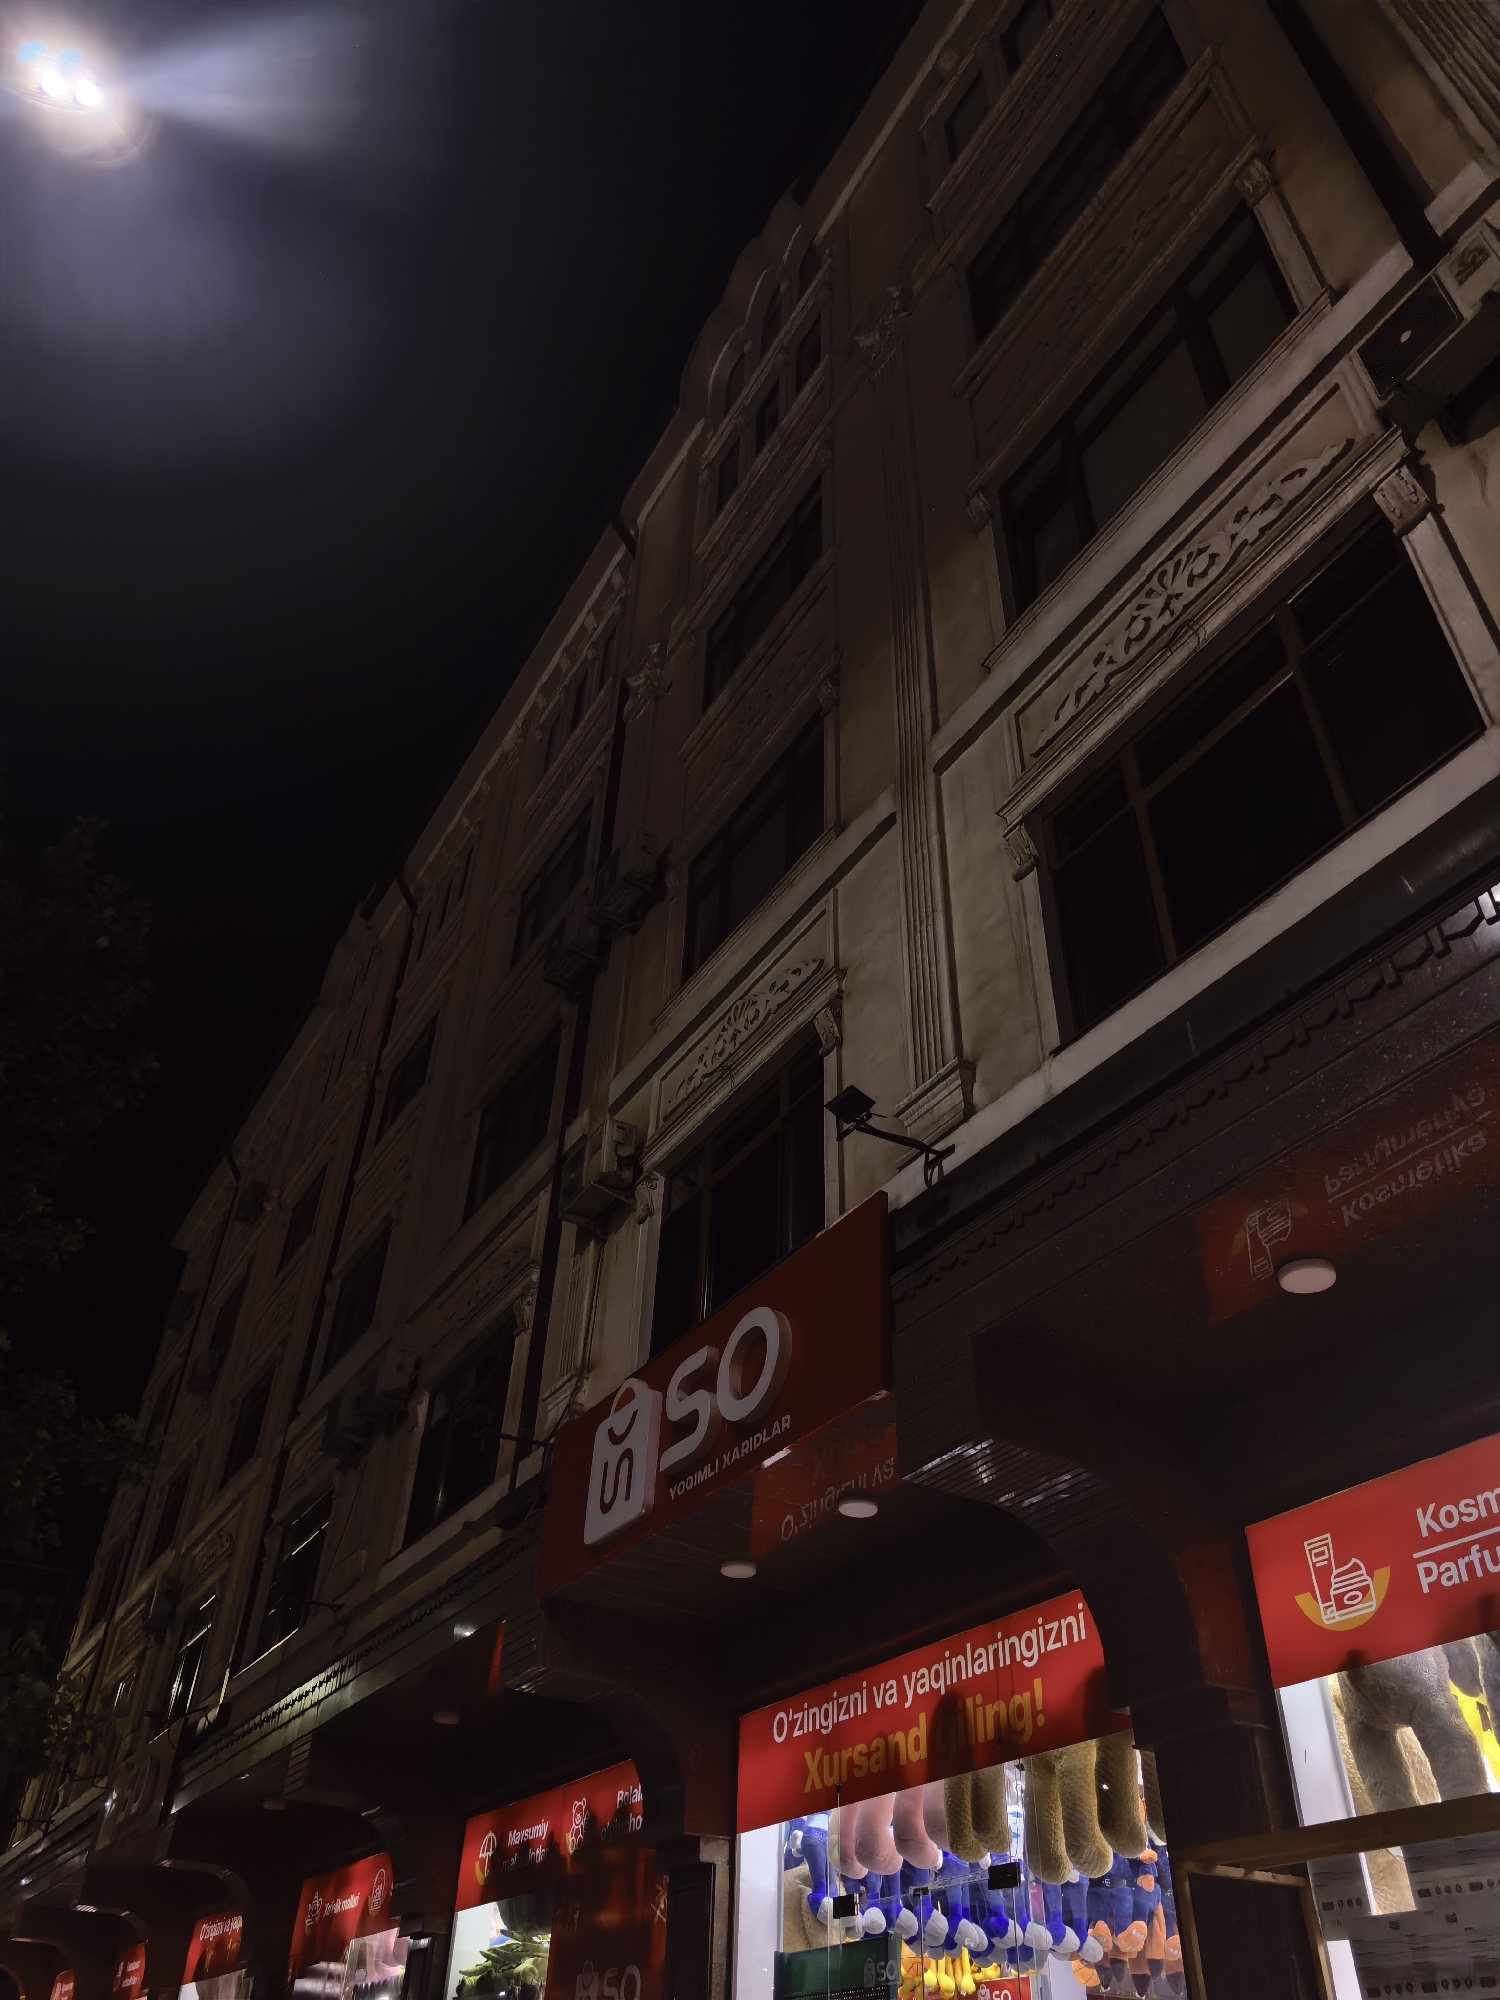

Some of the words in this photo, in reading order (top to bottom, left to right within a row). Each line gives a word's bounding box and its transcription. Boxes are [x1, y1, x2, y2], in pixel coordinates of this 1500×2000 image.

[669, 1457, 719, 1501] YOQIMLI
[721, 1414, 792, 1470] XARIDLAR
[873, 1678, 898, 1710] va
[902, 1602, 1088, 1709] yaqinlaringizni
[803, 1712, 929, 1794] Xursand
[935, 1677, 1046, 1763] qiling!
